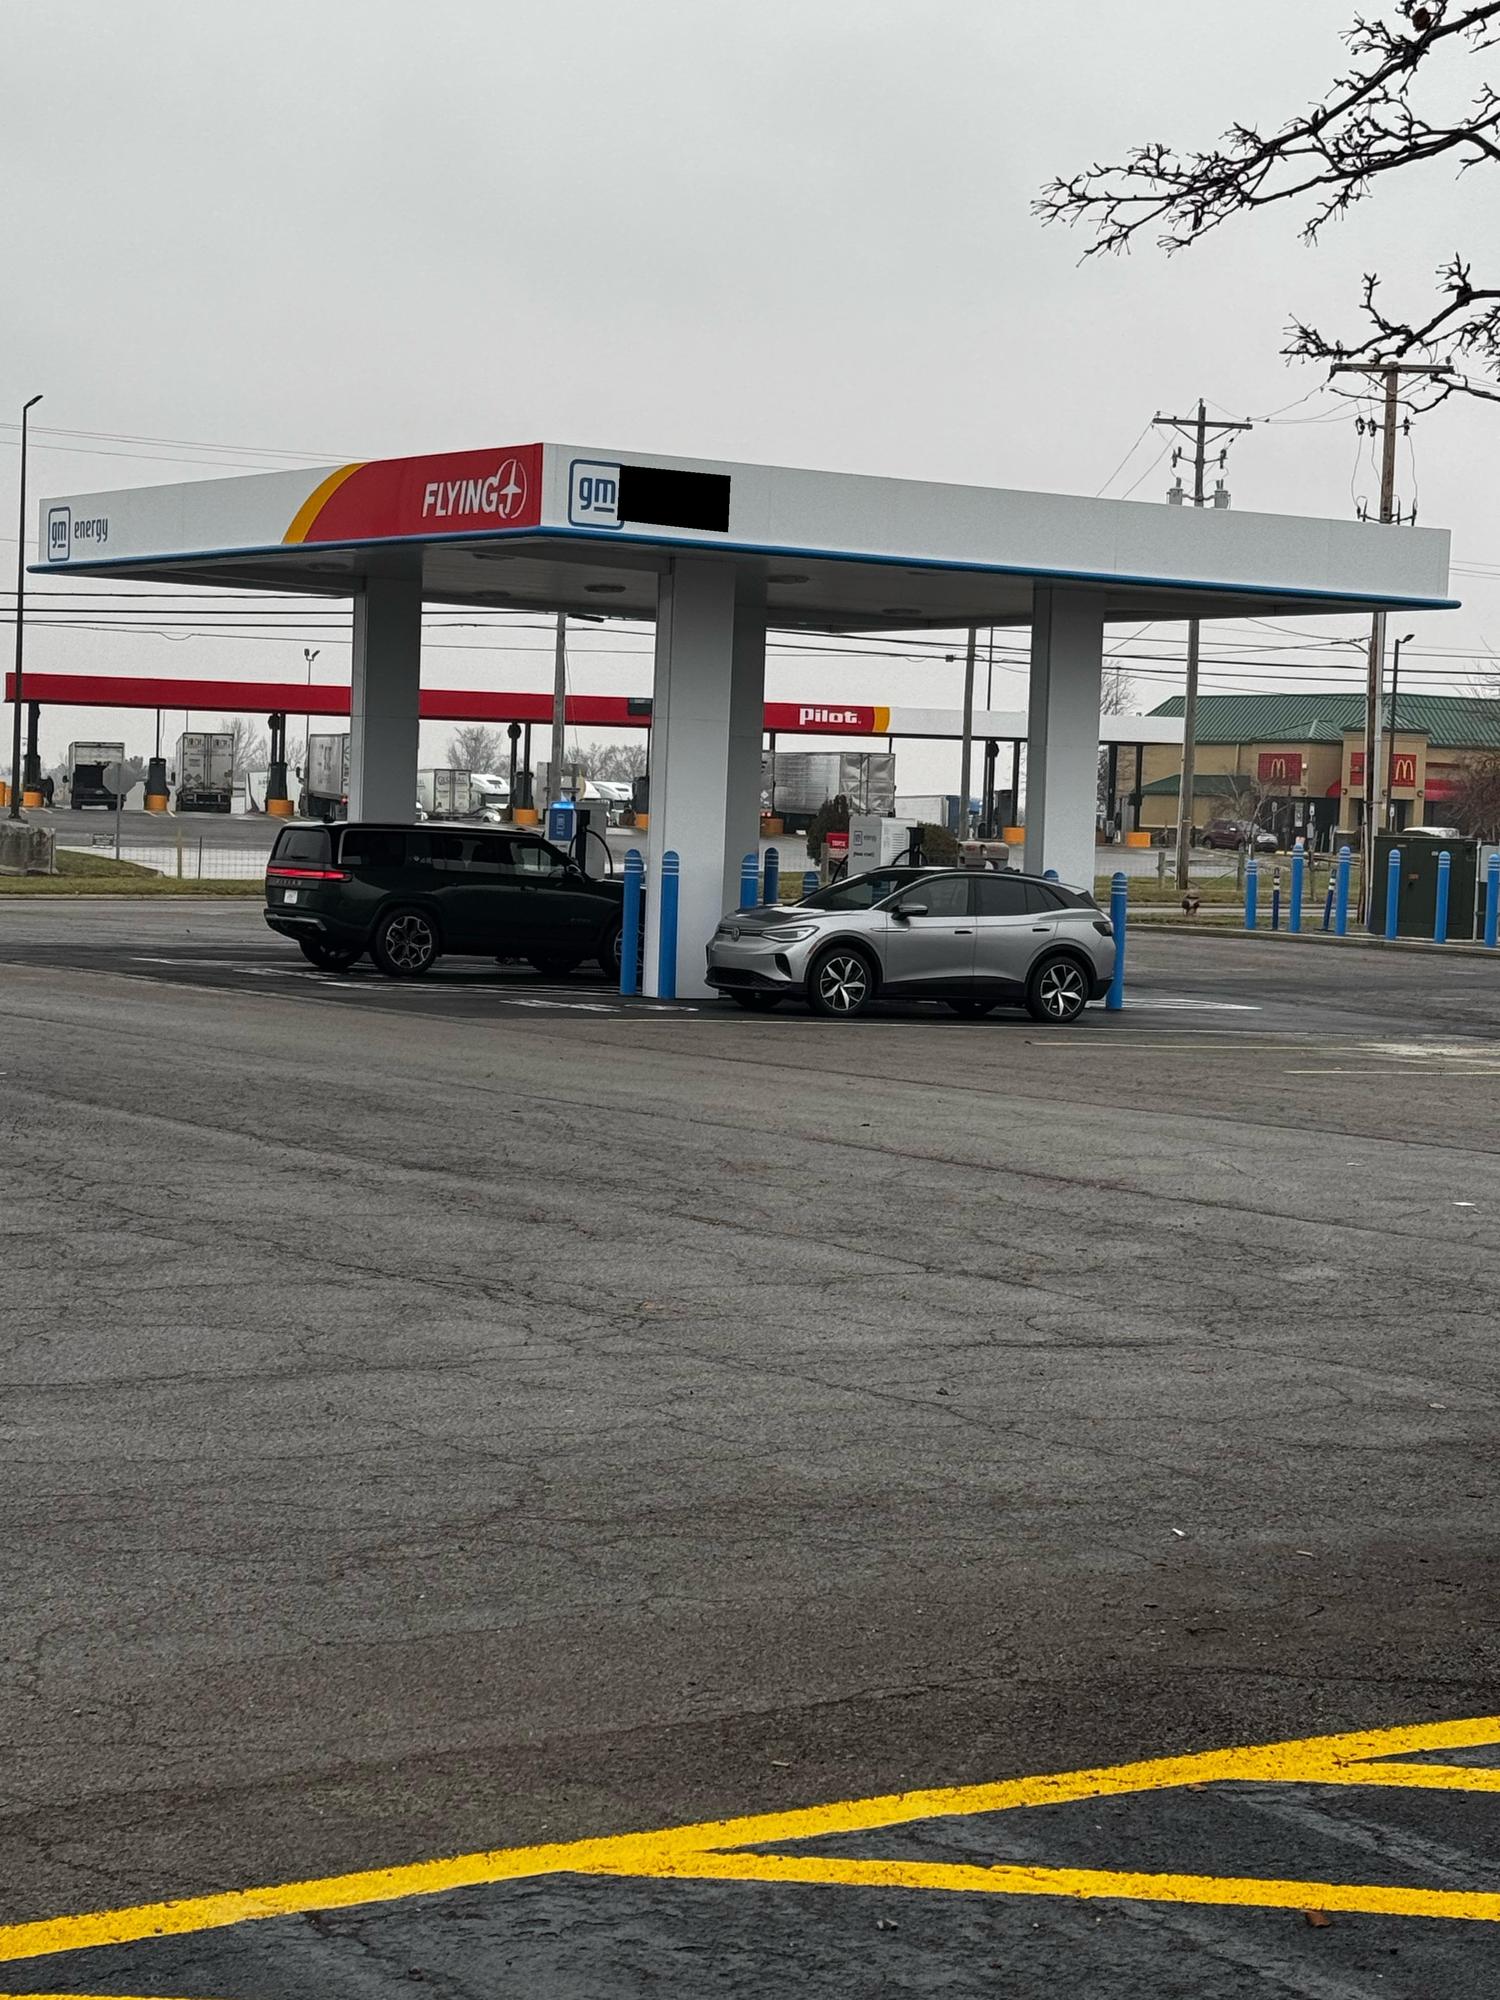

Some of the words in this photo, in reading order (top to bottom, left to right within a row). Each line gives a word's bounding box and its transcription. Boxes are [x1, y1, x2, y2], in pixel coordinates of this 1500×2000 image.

[422, 476, 499, 518] FLYING
[579, 477, 616, 513] gm
[51, 521, 67, 549] gm
[74, 518, 108, 543] energy
[799, 708, 858, 725] Pilot
